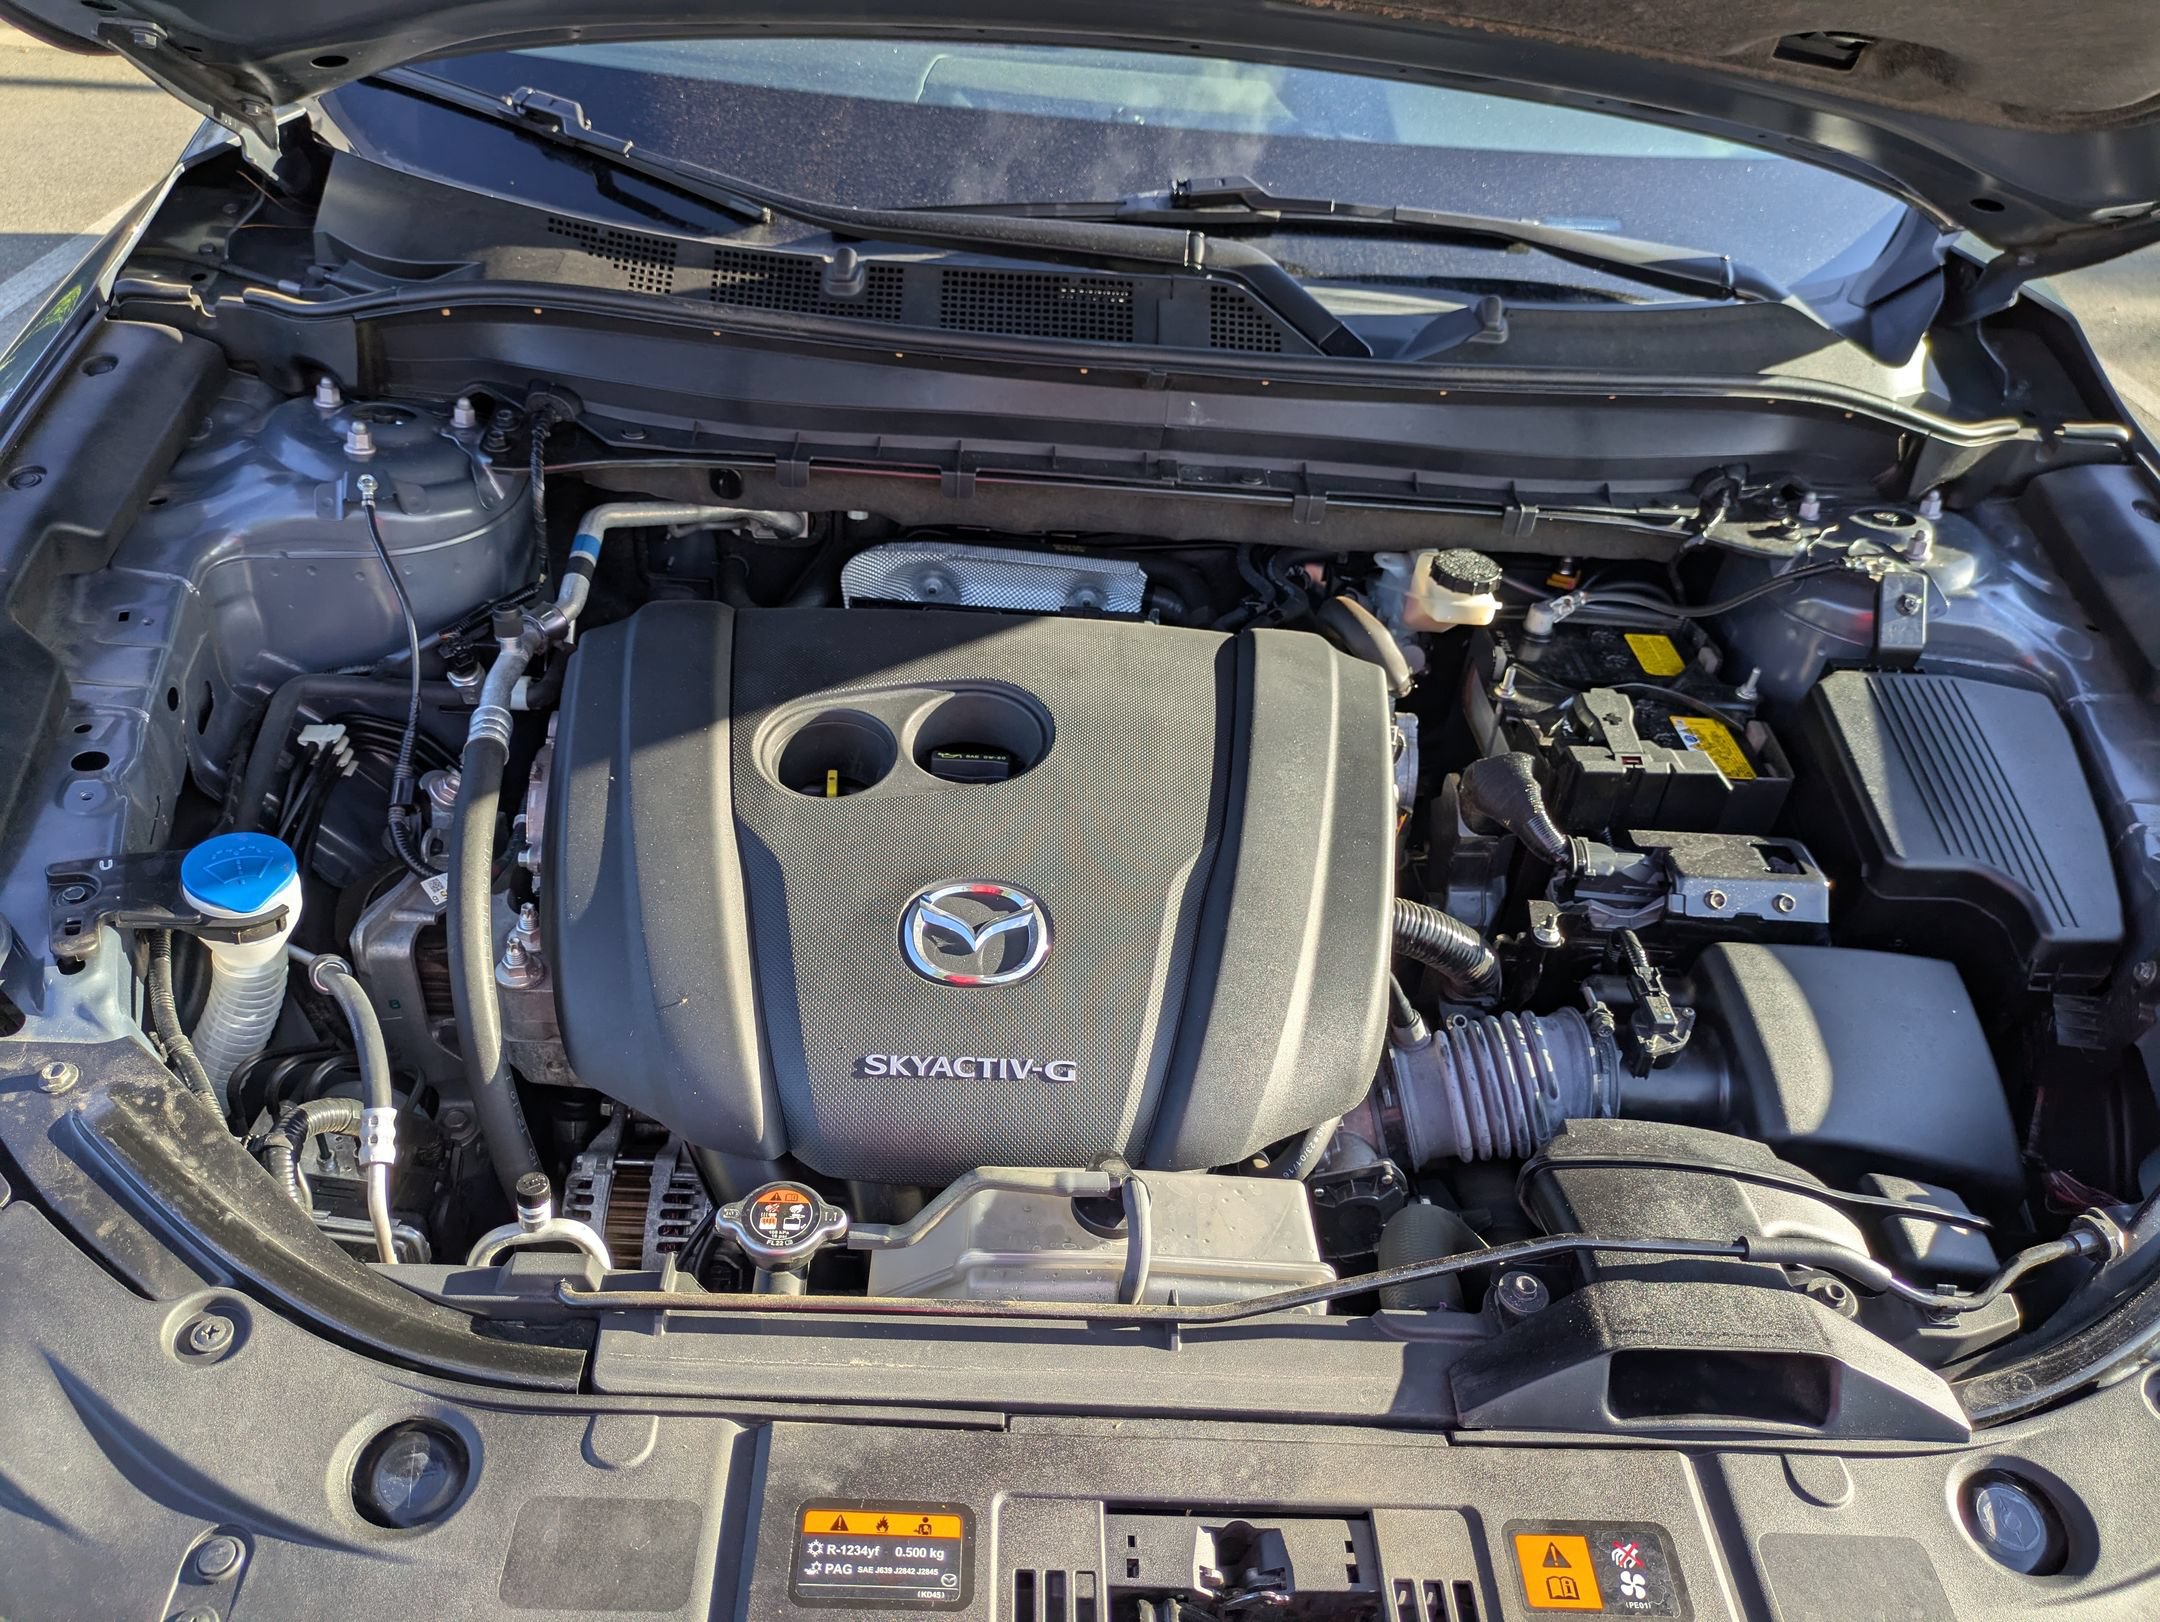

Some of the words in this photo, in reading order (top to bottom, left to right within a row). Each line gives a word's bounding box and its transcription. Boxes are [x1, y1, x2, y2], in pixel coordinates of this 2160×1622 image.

[863, 1054, 1077, 1082] SKYACTIV-G
[766, 1239, 784, 1247] FL22
[826, 1544, 880, 1558] R-1234yf
[895, 1547, 927, 1558] 0.500
[929, 1548, 945, 1560] kg
[824, 1563, 853, 1575] PAG
[857, 1566, 874, 1574] SAE
[893, 1567, 915, 1575] J2842
[916, 1567, 939, 1576] J2845
